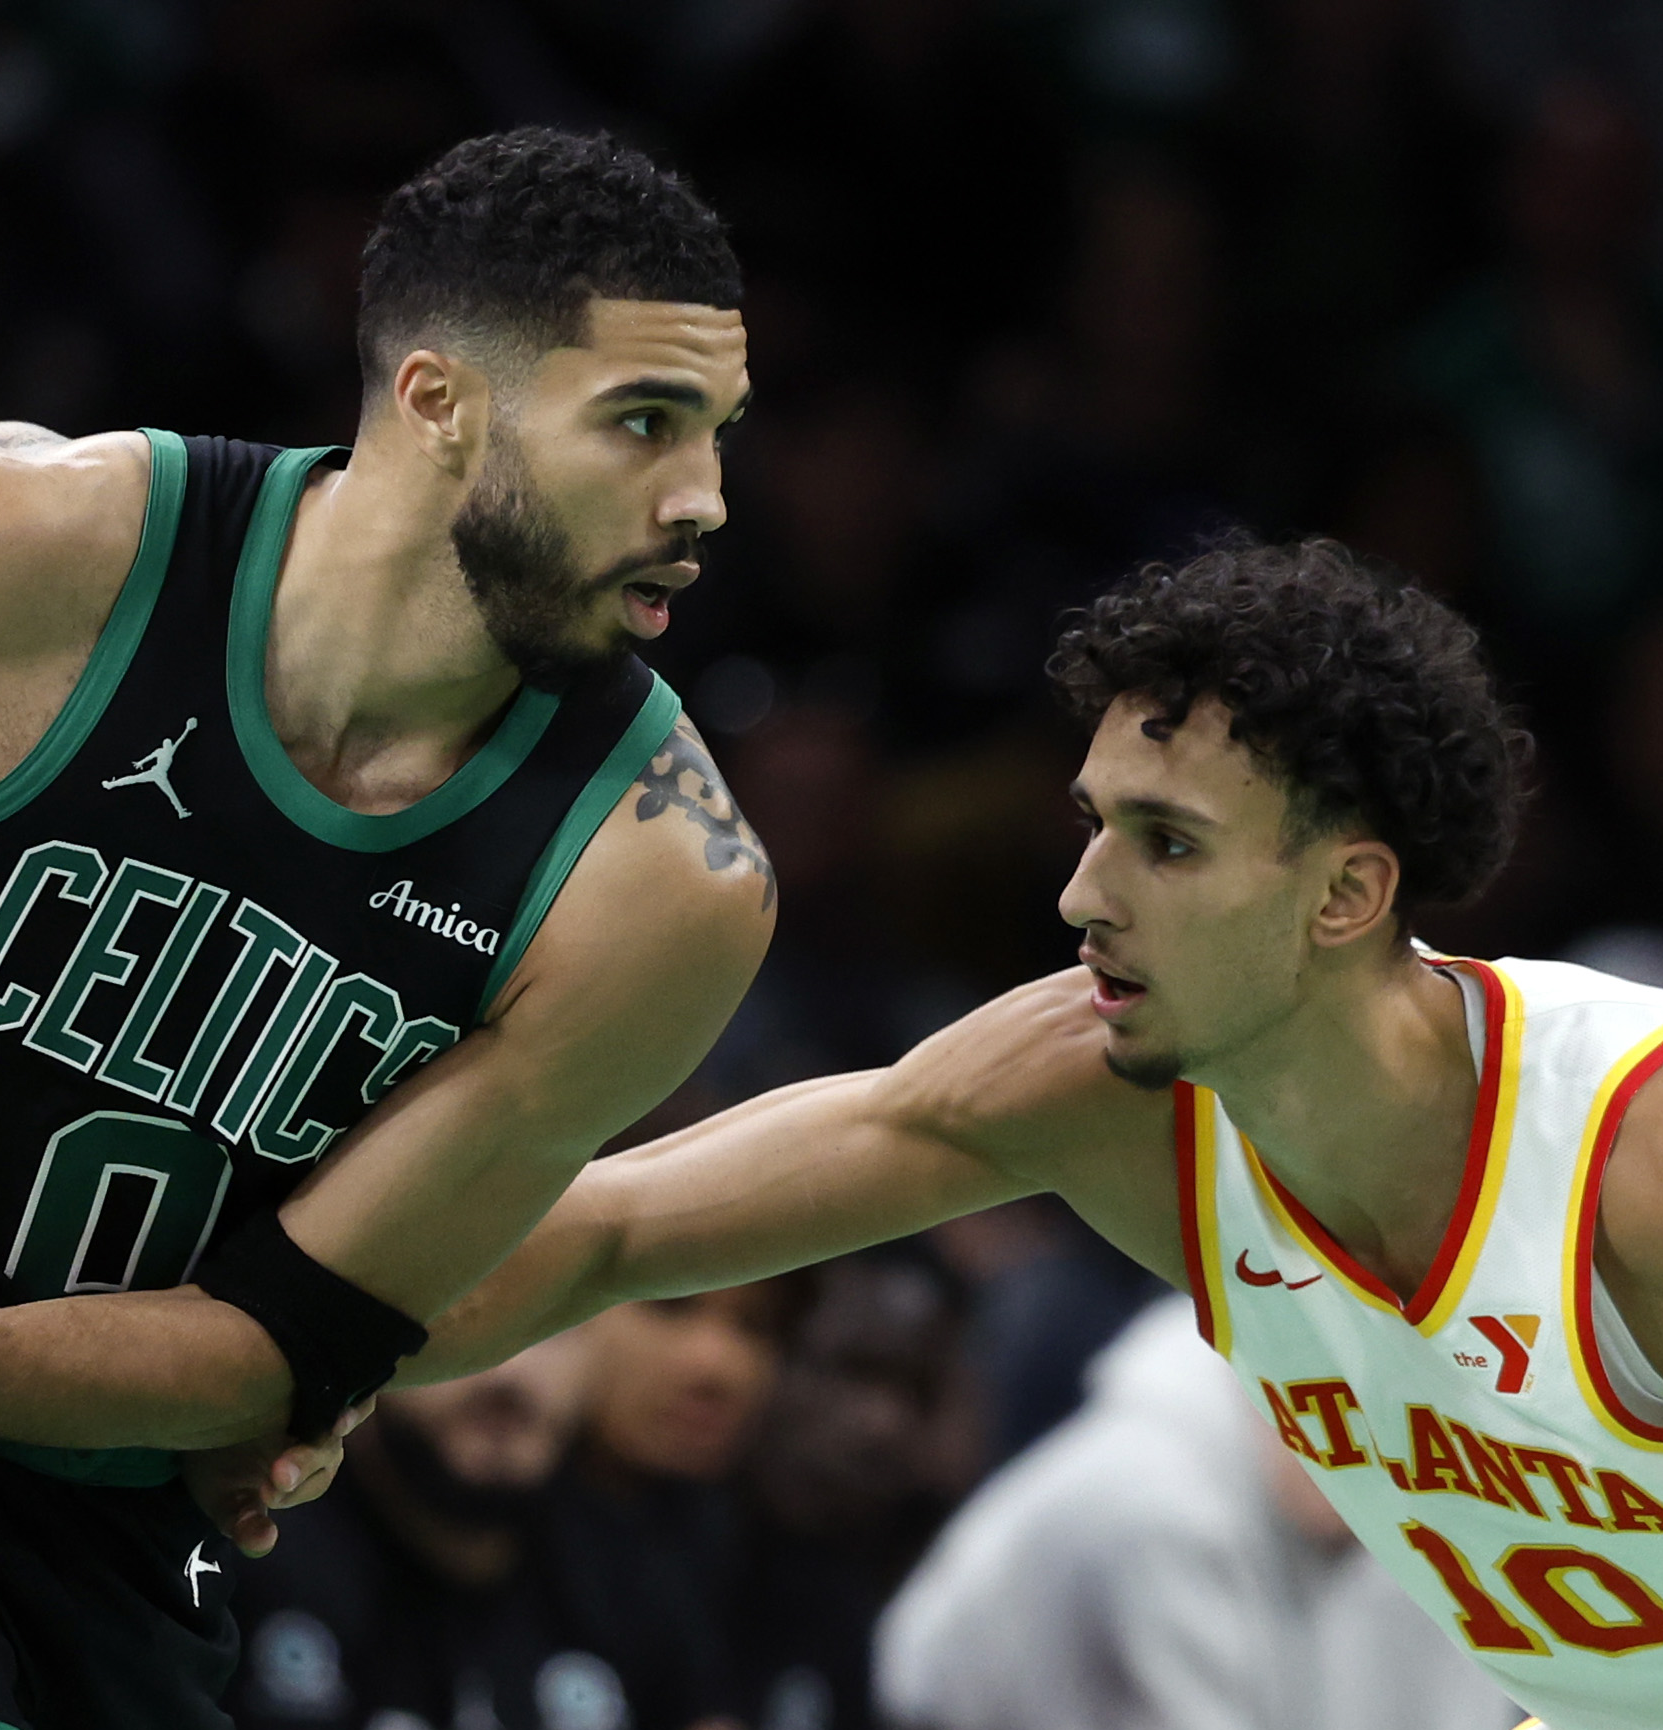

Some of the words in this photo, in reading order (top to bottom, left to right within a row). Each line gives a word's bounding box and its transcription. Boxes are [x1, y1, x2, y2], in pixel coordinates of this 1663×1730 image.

[369, 880, 500, 956] Amica
[4, 1109, 234, 1294] 0
[1453, 1352, 1488, 1368] the
